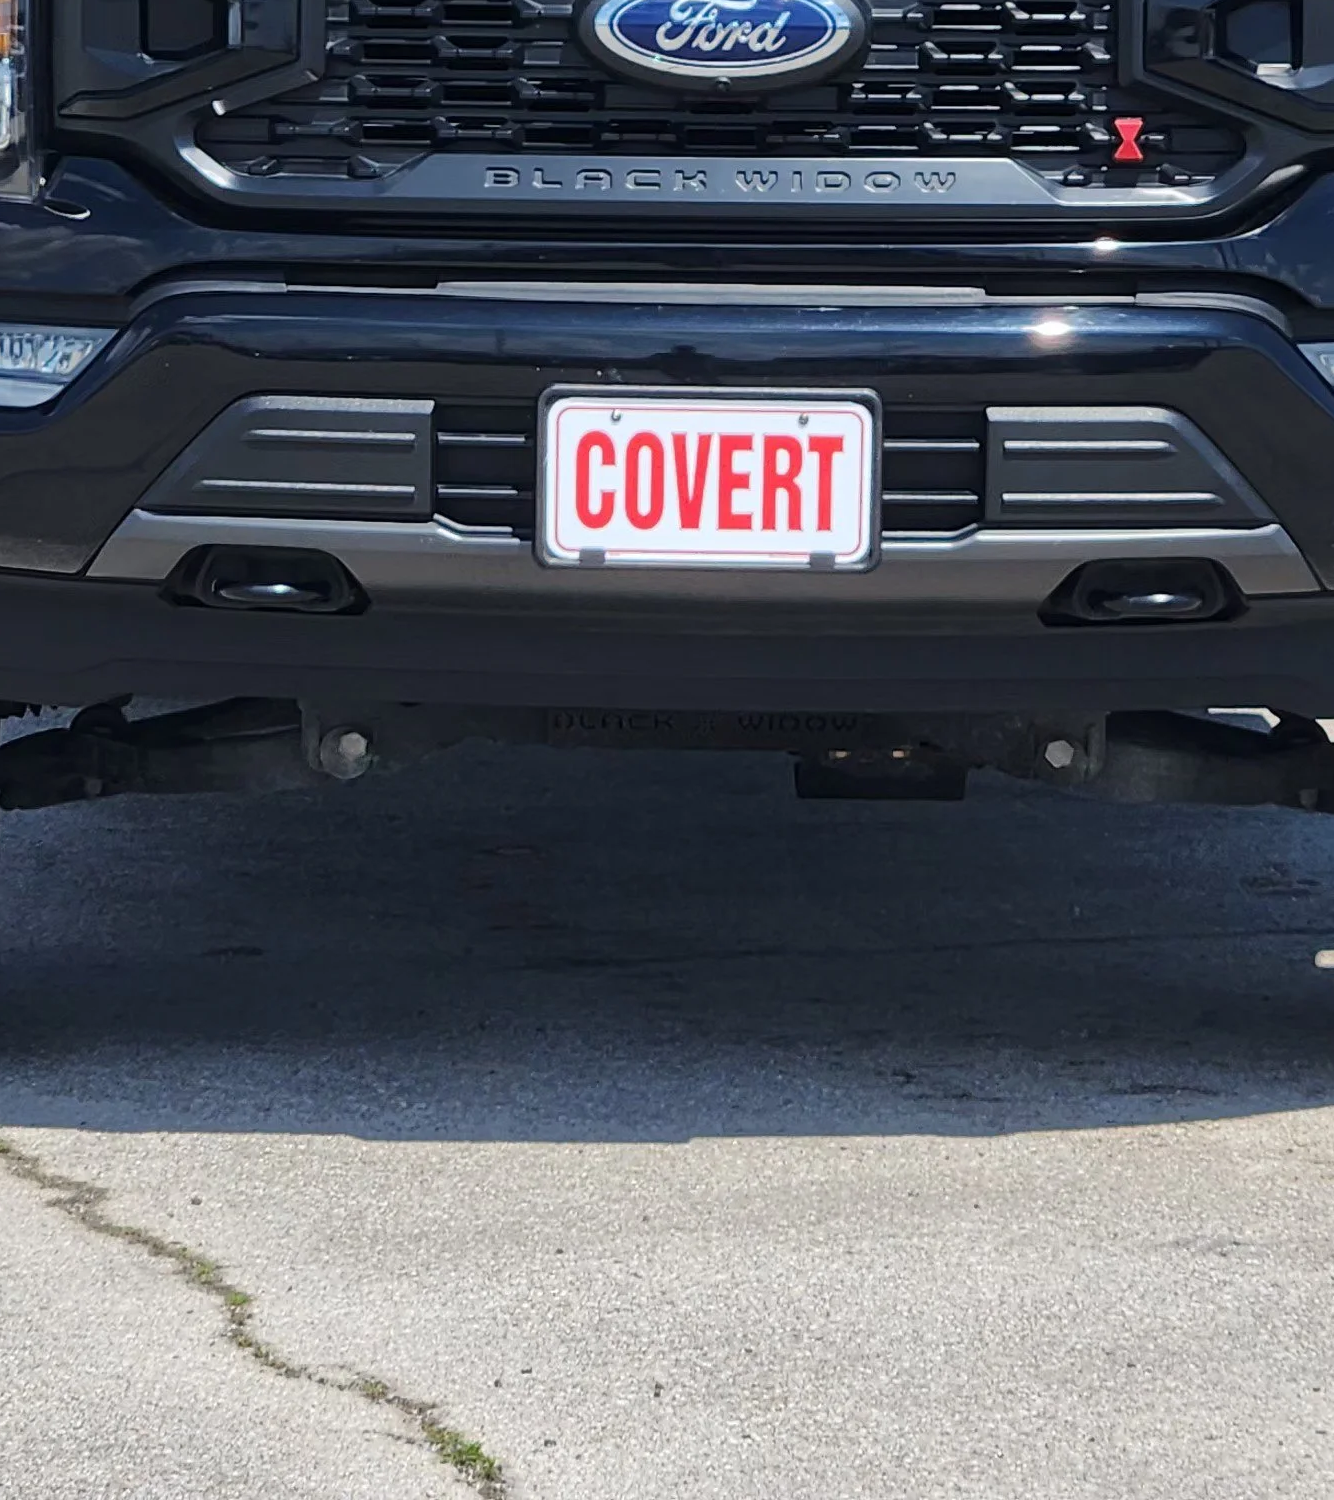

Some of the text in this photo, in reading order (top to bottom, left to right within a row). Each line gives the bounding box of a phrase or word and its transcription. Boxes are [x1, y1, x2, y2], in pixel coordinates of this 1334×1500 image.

[483, 166, 957, 194] BLACK WIDOW
[575, 429, 845, 532] COVERT
